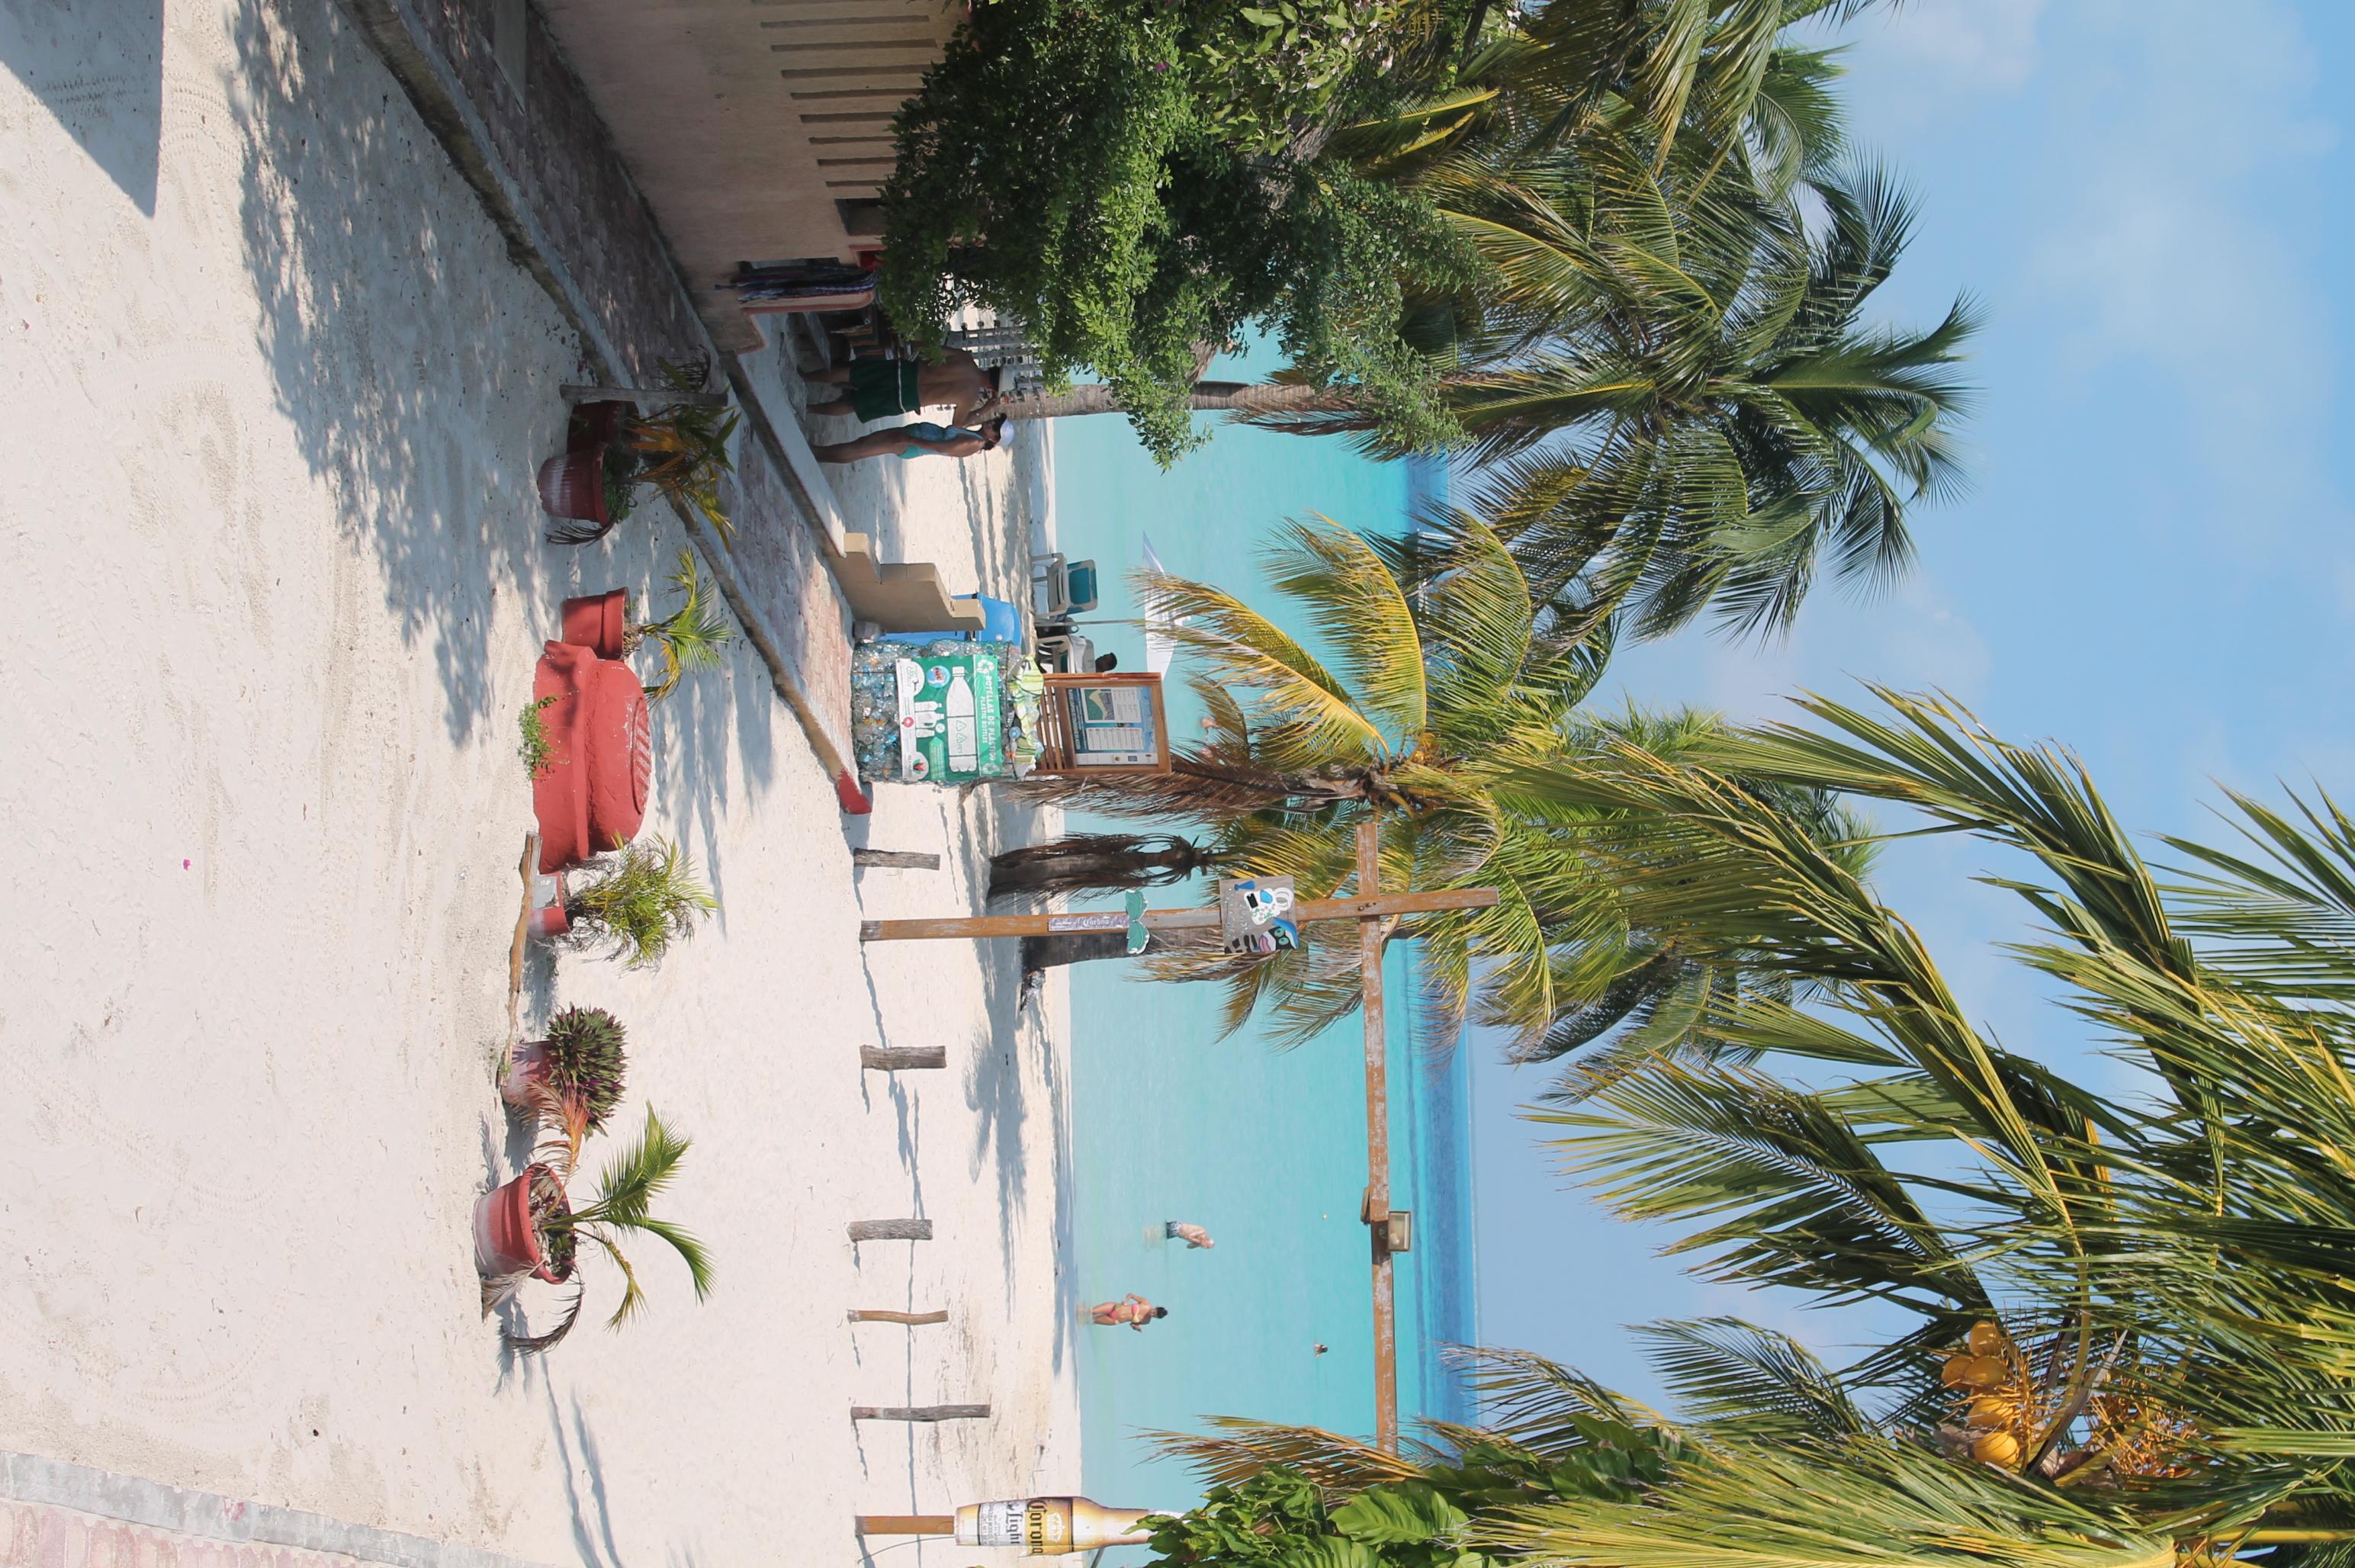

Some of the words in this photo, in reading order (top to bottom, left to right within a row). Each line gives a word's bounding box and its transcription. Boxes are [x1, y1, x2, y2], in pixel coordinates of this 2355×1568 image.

[985, 675, 994, 713] BOTELLAS
[988, 715, 994, 725] DE
[1082, 918, 1110, 928] Corona
[1006, 1511, 1023, 1544] Light
[1025, 1500, 1048, 1554] Corona
